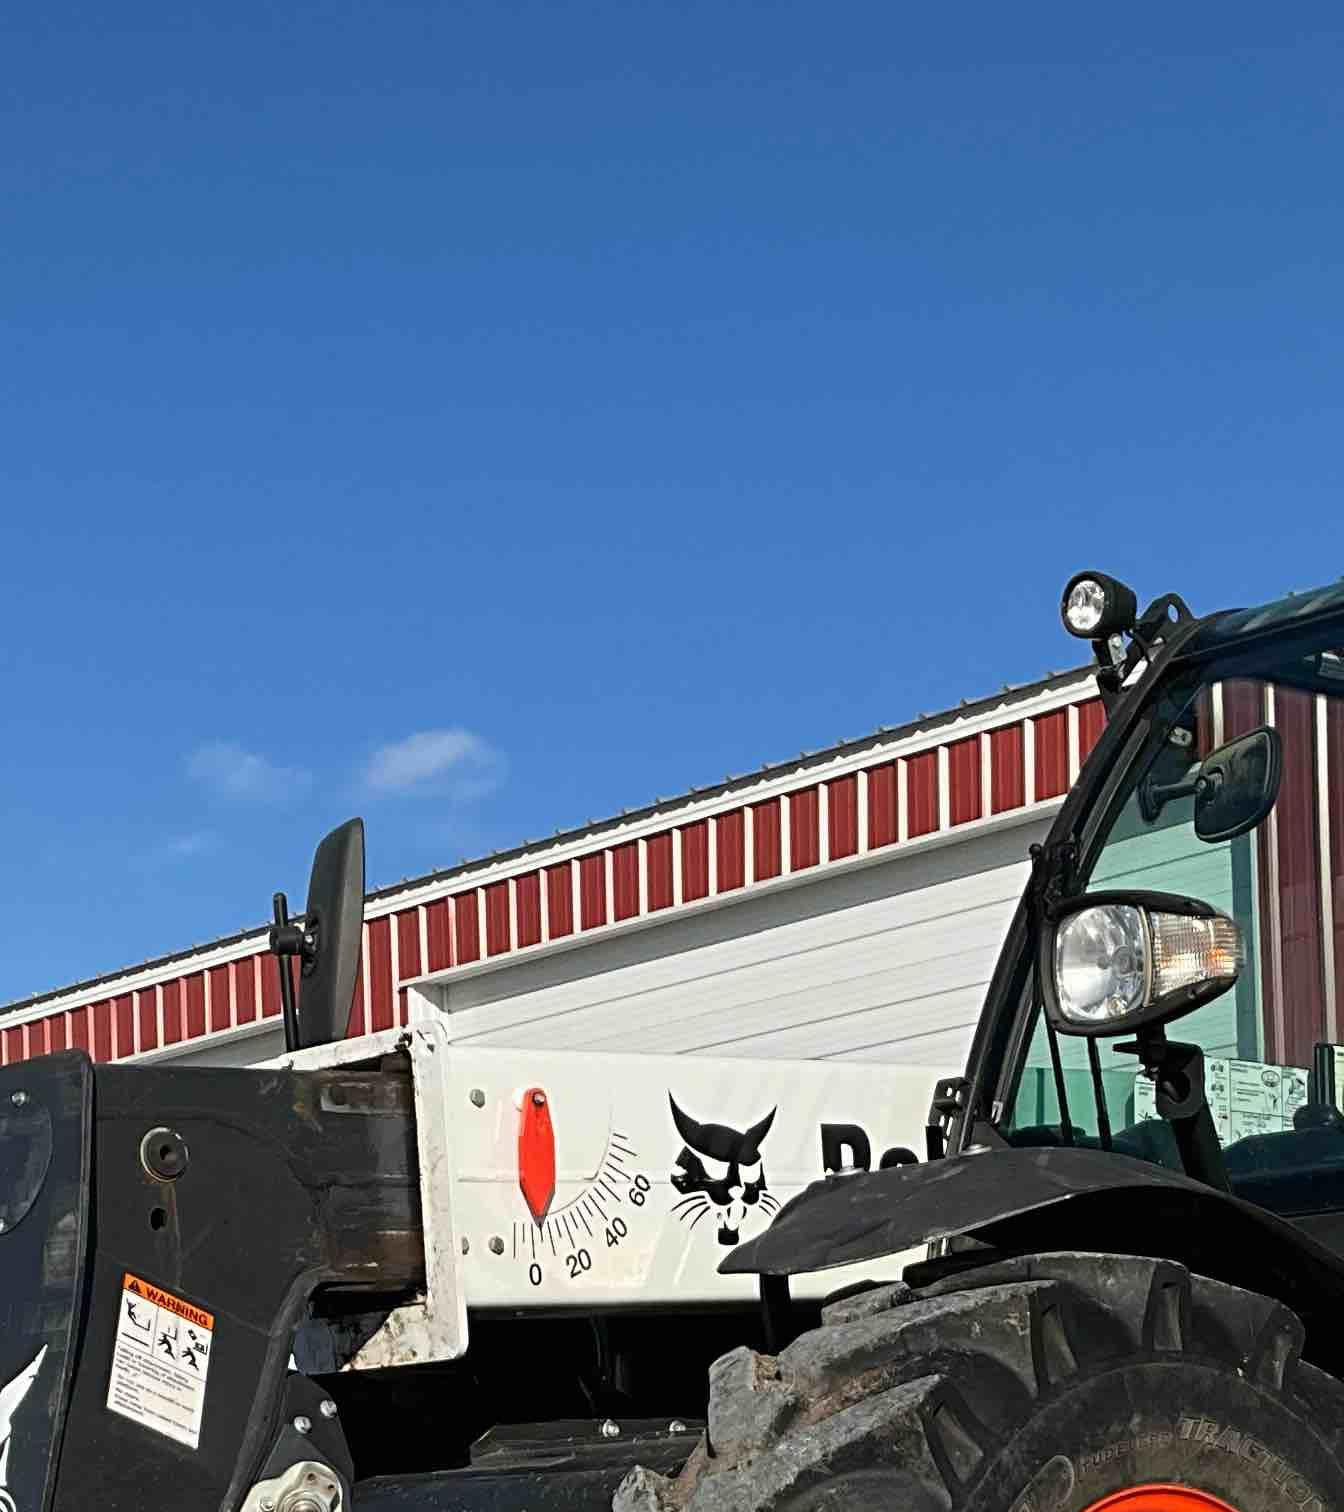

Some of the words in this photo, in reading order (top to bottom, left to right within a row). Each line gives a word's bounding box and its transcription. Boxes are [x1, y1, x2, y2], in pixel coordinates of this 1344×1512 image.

[628, 1174, 652, 1207] 60
[605, 1216, 629, 1248] 40
[529, 1262, 543, 1286] 0
[565, 1248, 593, 1279] 20
[145, 1287, 209, 1326] WARNING
